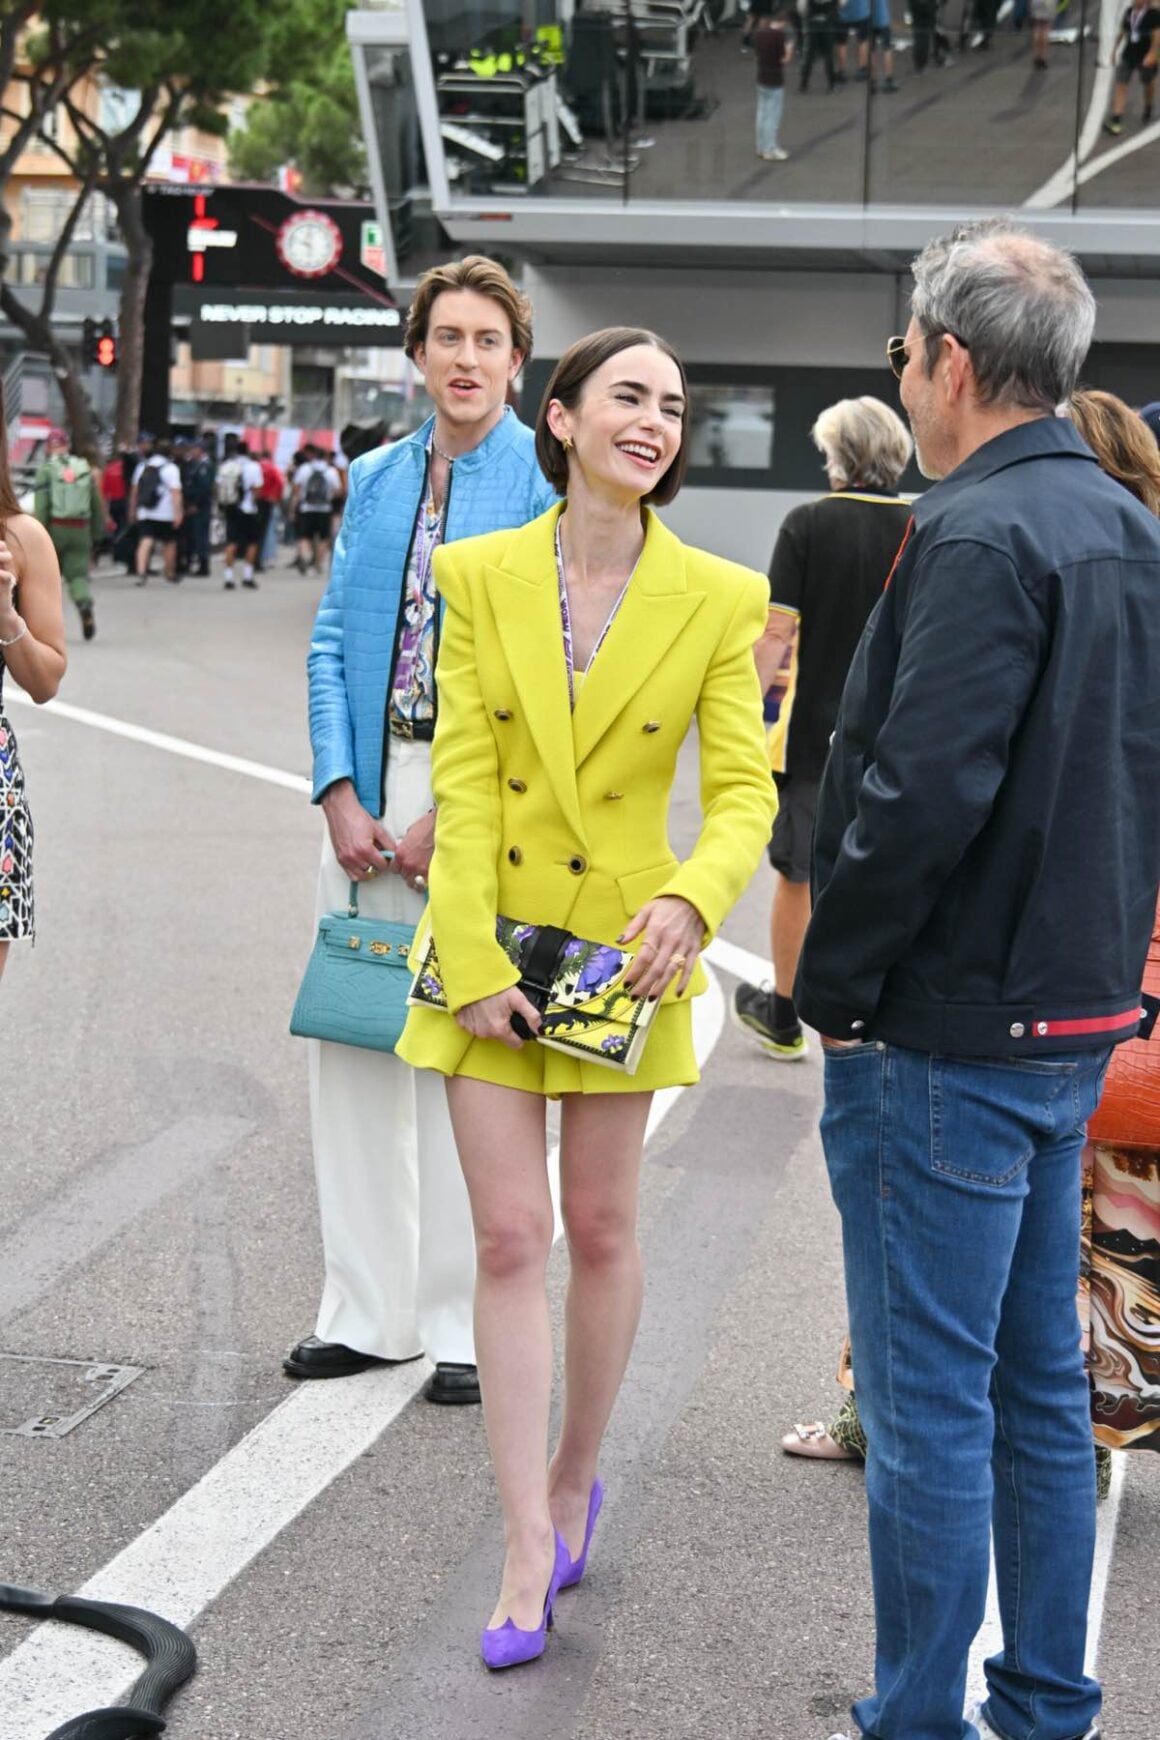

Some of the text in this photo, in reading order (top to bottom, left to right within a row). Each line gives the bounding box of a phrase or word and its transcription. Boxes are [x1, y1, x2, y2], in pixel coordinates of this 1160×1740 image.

[201, 305, 400, 326] NEVER STOP RACING
